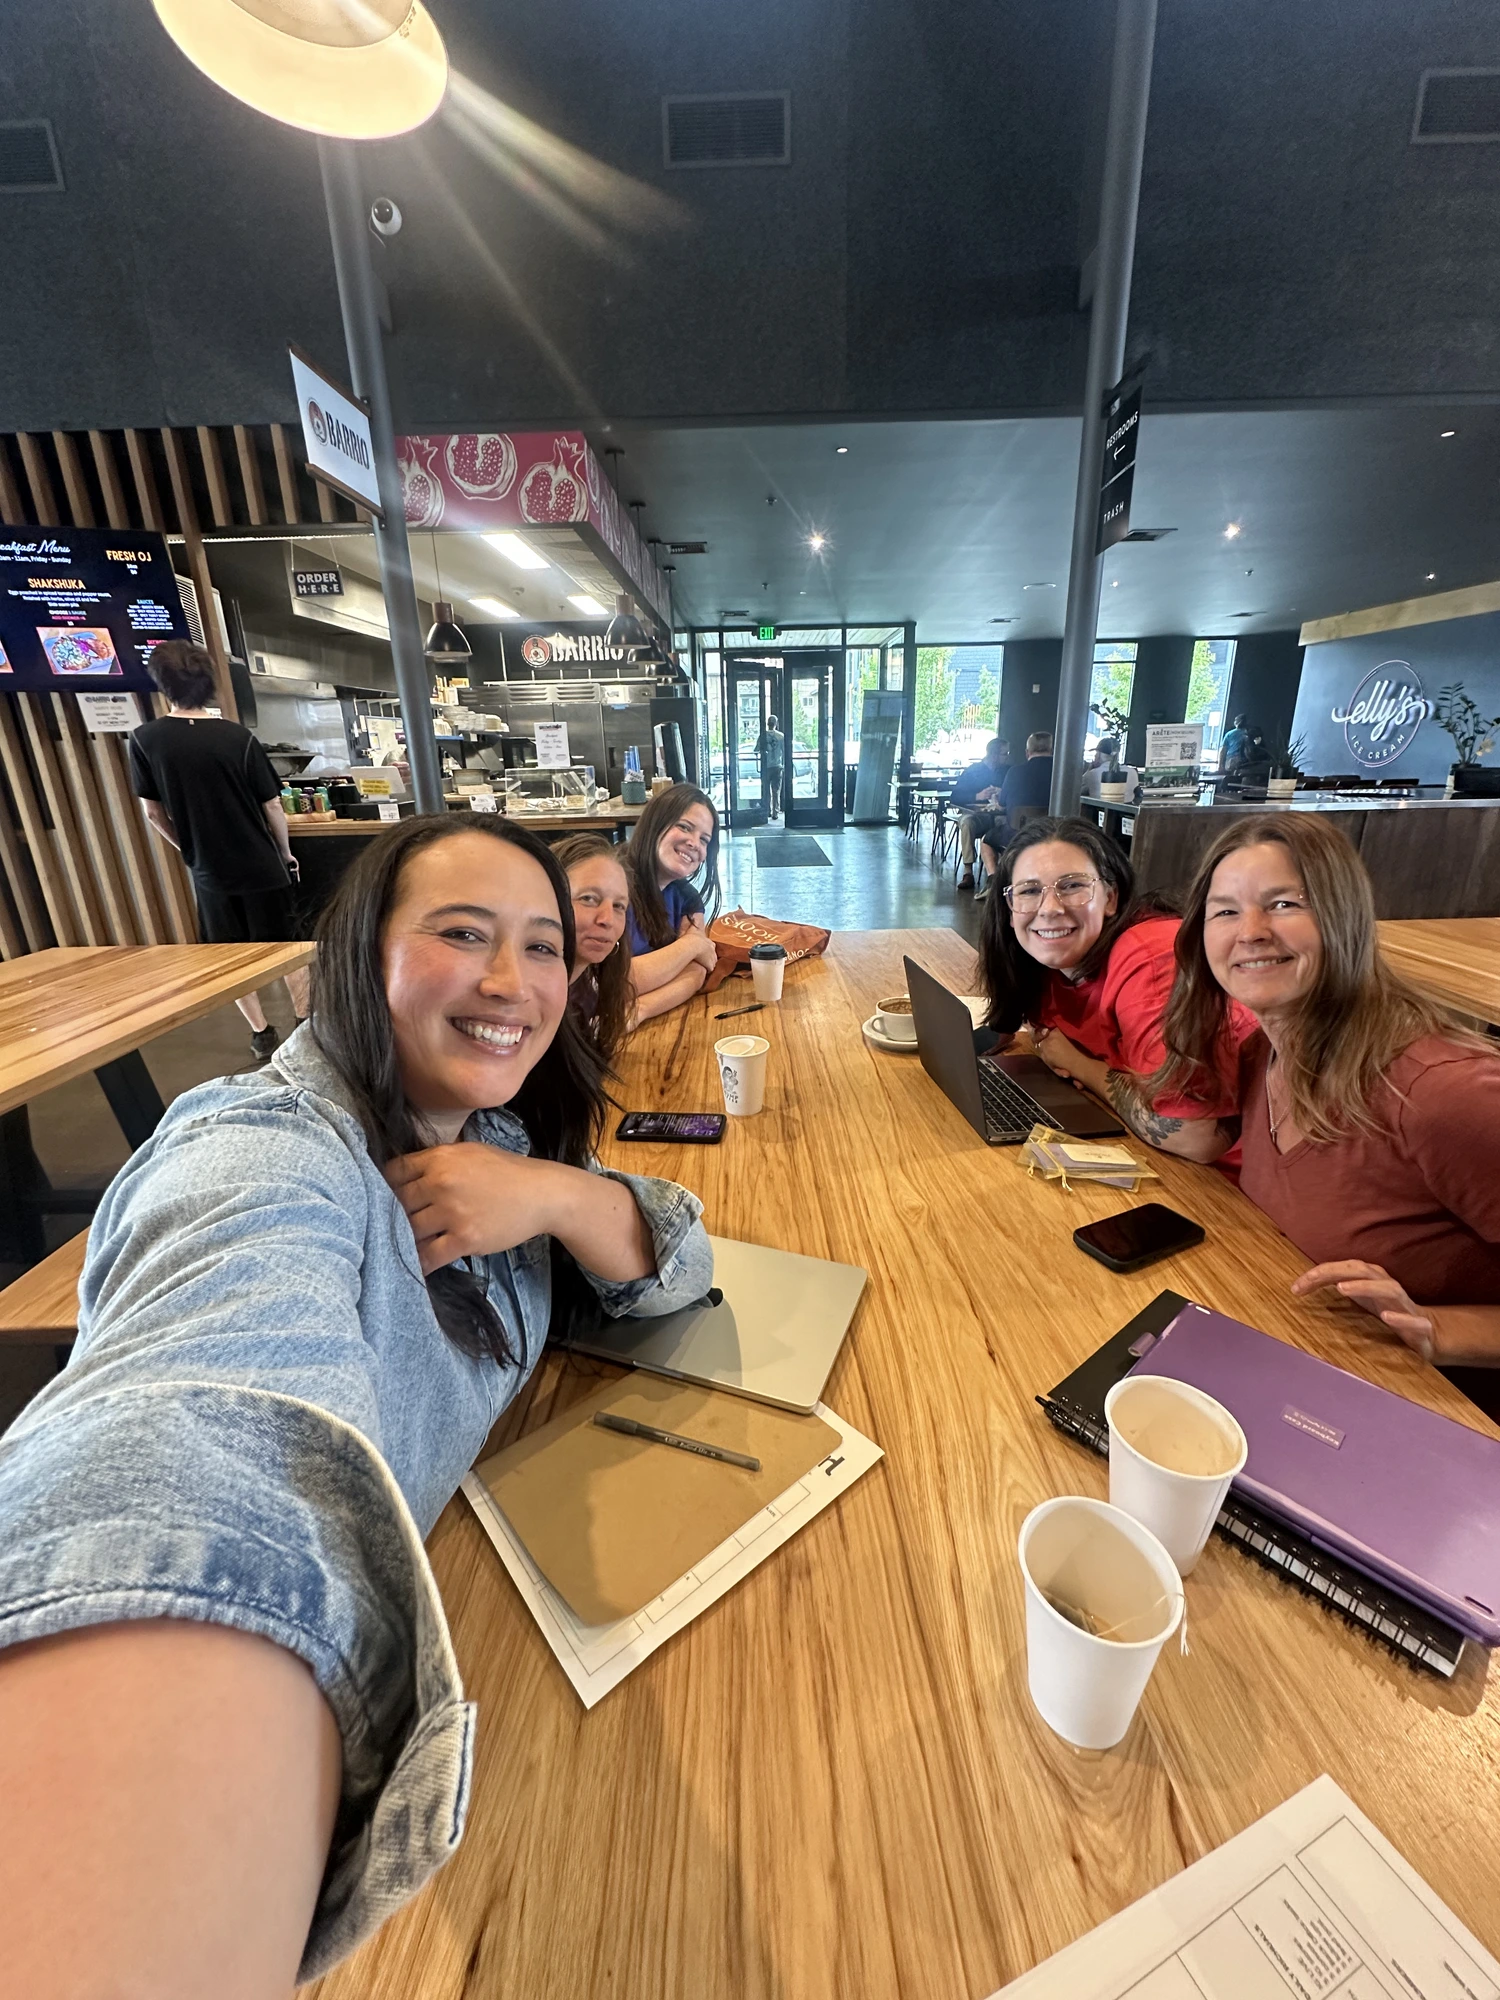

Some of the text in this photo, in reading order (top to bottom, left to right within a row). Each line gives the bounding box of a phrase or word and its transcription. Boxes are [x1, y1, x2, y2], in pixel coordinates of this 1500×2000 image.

[1106, 411, 1138, 450] RESTROOMS
[325, 410, 370, 470] BARRIO
[1103, 501, 1125, 524] TRASH
[37, 540, 71, 553] Menu
[106, 550, 152, 561] FRESH OJ
[28, 578, 86, 590] SHAKSHUKA
[297, 573, 338, 583] ORDER
[760, 627, 774, 640] EXIT
[1332, 680, 1426, 741] elly's
[1351, 734, 1405, 759] ICE CREAM
